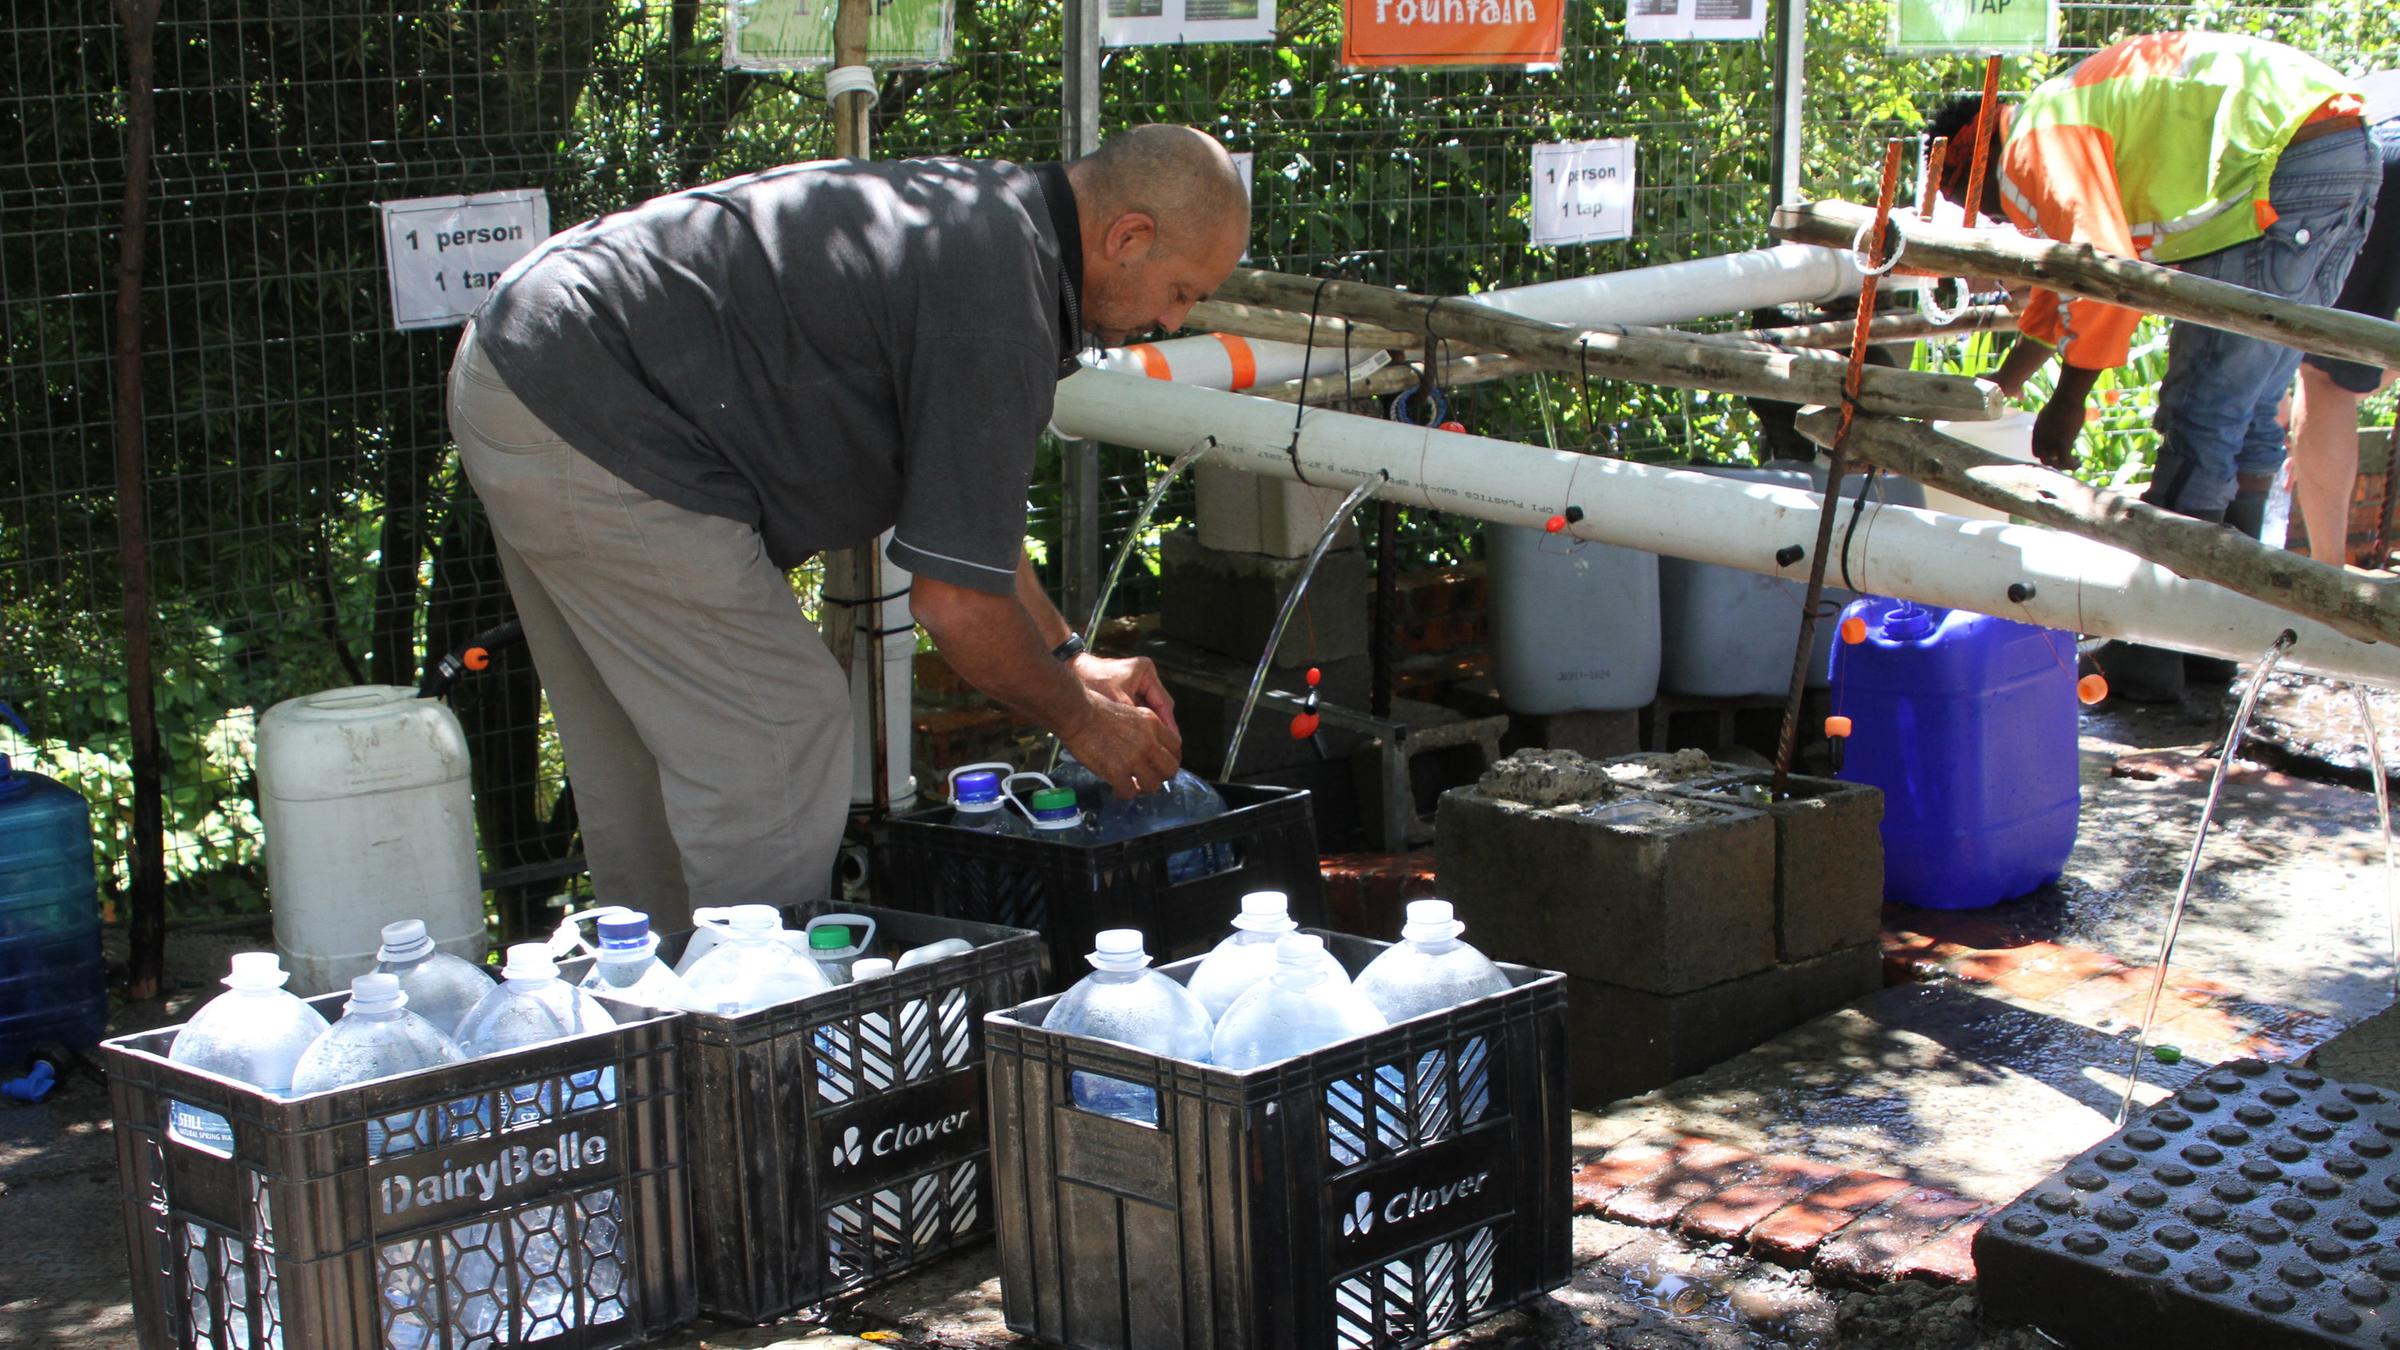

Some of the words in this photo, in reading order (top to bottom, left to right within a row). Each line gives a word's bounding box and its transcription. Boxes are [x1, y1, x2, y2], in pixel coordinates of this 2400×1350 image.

[1547, 168, 1555, 184] 1
[1568, 166, 1616, 186] person
[1562, 202, 1569, 218] 1
[1576, 201, 1602, 218] tap
[405, 229, 419, 250] 1
[436, 224, 523, 252] person
[435, 271, 446, 291] 1
[1465, 491, 1523, 509] PLASTICS
[179, 1113, 203, 1130] STILL
[199, 1131, 221, 1141] SPRING
[872, 1109, 970, 1158] Clover
[381, 1131, 609, 1215] DairyBelle
[1384, 1168, 1489, 1224] Clover
